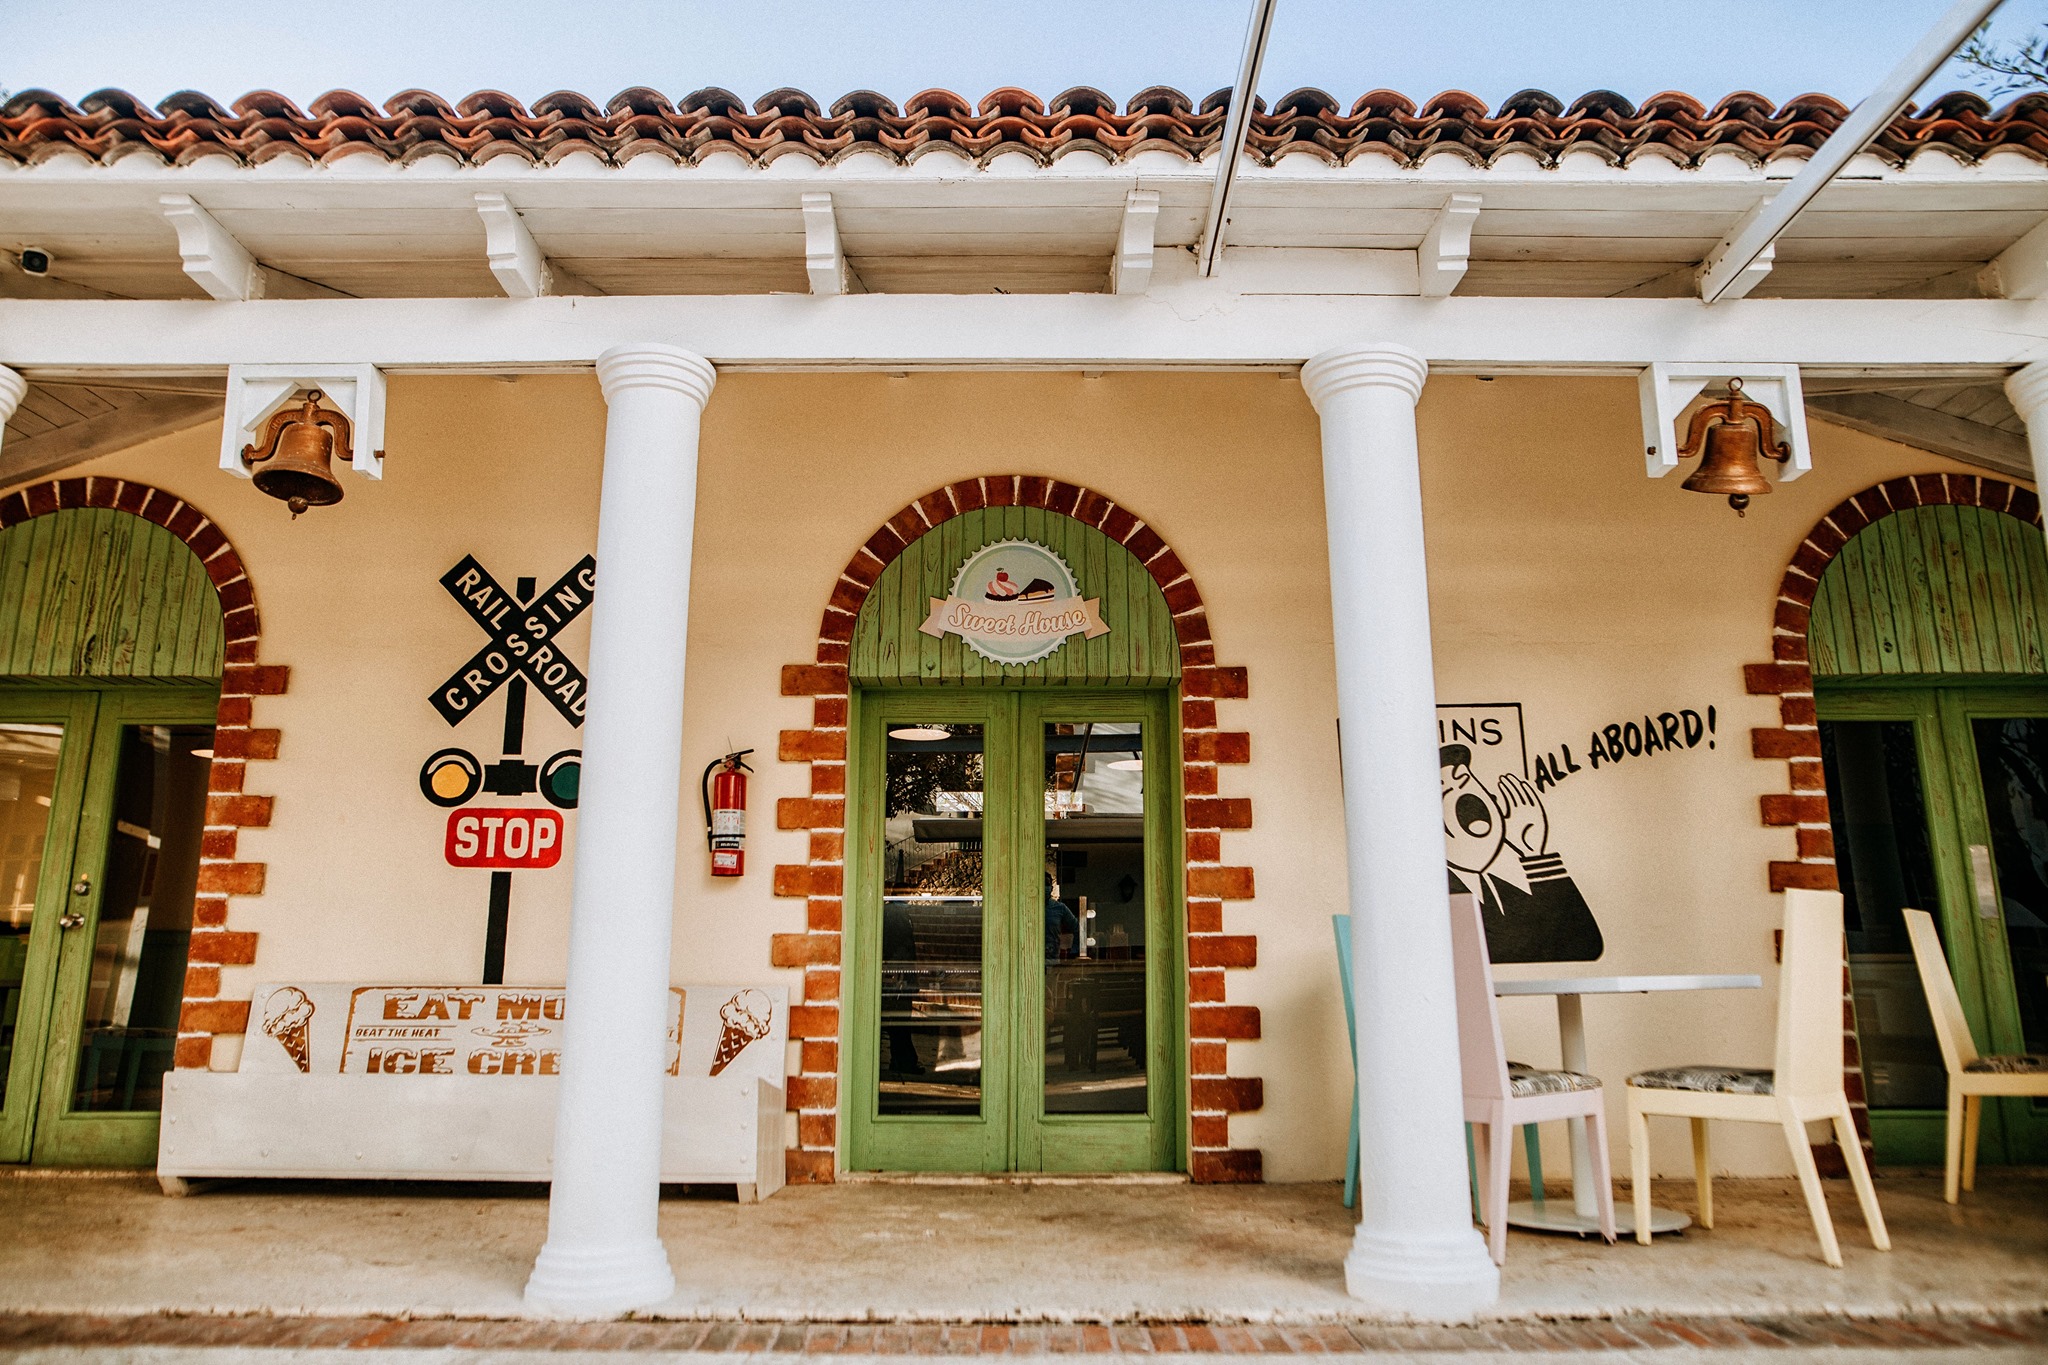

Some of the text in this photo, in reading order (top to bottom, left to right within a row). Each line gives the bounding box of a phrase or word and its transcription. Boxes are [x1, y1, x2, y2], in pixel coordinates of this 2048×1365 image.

[948, 603, 1087, 635] Sweet House
[445, 568, 596, 711] CROSSING
[455, 567, 587, 717] RAIL ROAD
[1535, 705, 1716, 793] ALL ABOARD!
[455, 816, 557, 859] STOP
[382, 993, 486, 1020] EAT
[356, 1028, 441, 1037] BEAT THE HEAT
[366, 1048, 456, 1075] ICE
